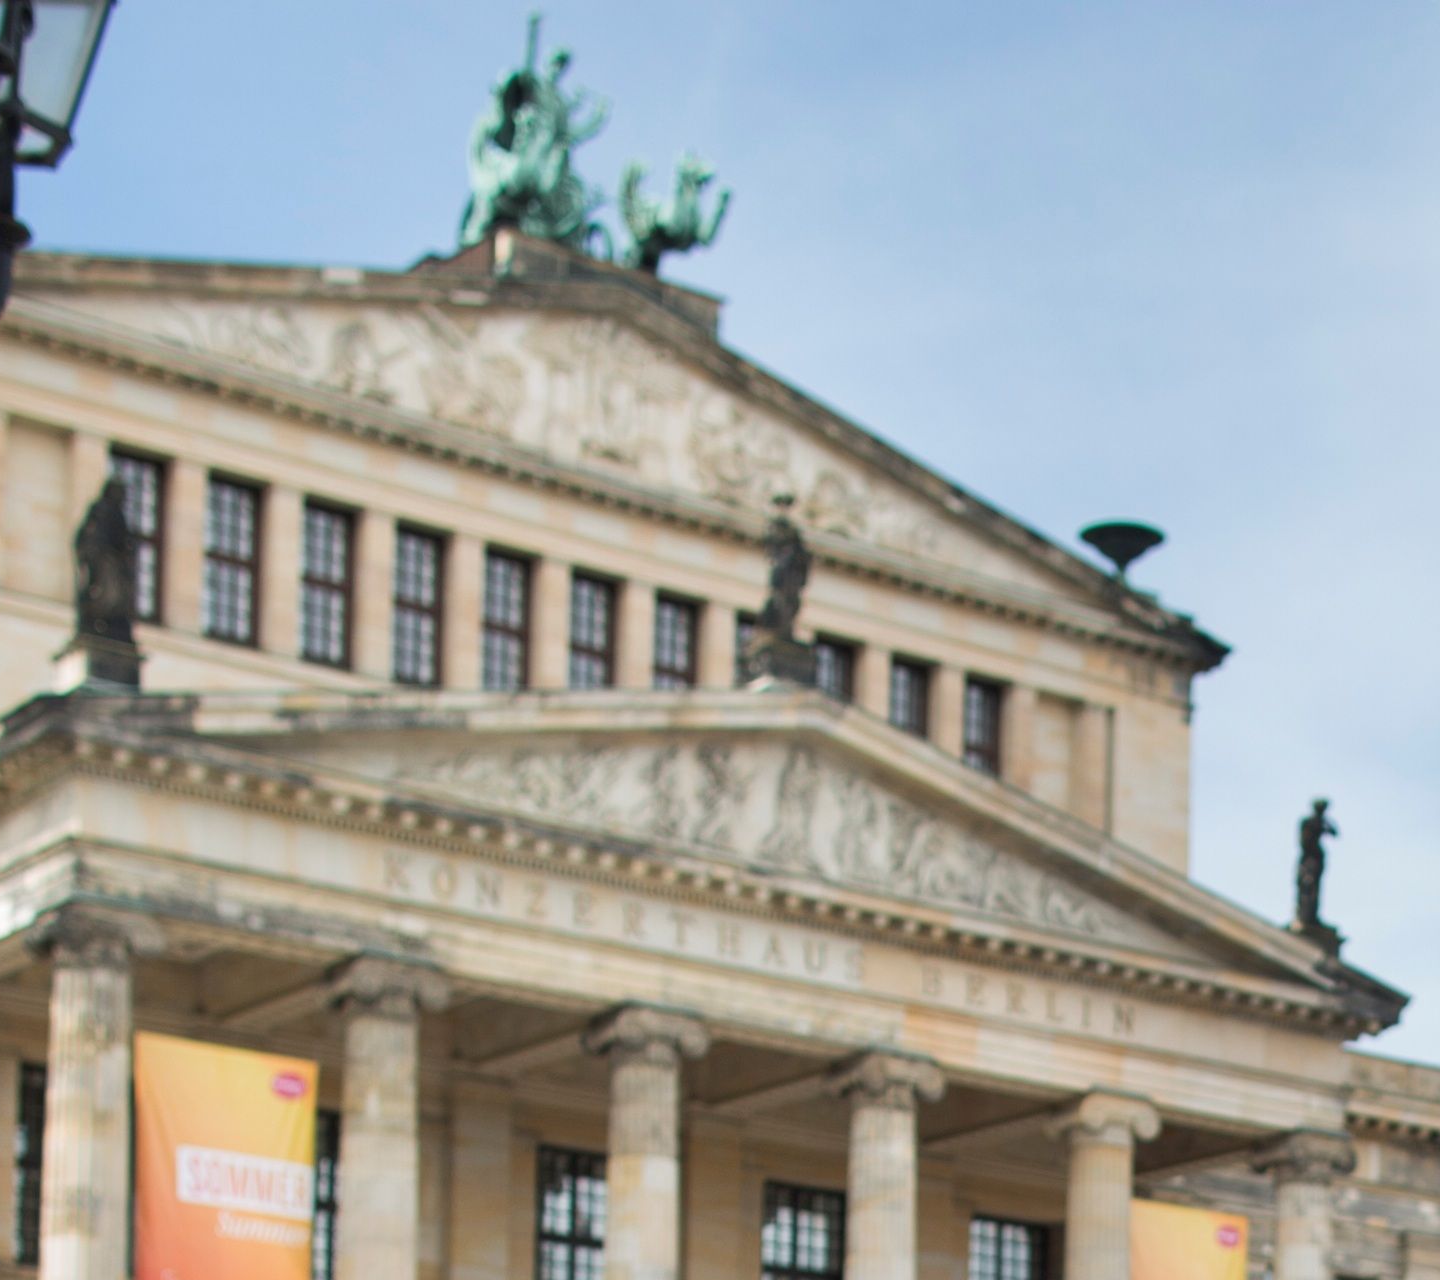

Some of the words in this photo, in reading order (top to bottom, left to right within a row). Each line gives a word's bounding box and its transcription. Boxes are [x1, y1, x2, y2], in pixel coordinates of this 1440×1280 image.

[382, 850, 867, 981] KONZERTHAUS
[920, 963, 1140, 1036] BERLIN
[187, 1151, 310, 1209] SOMMER
